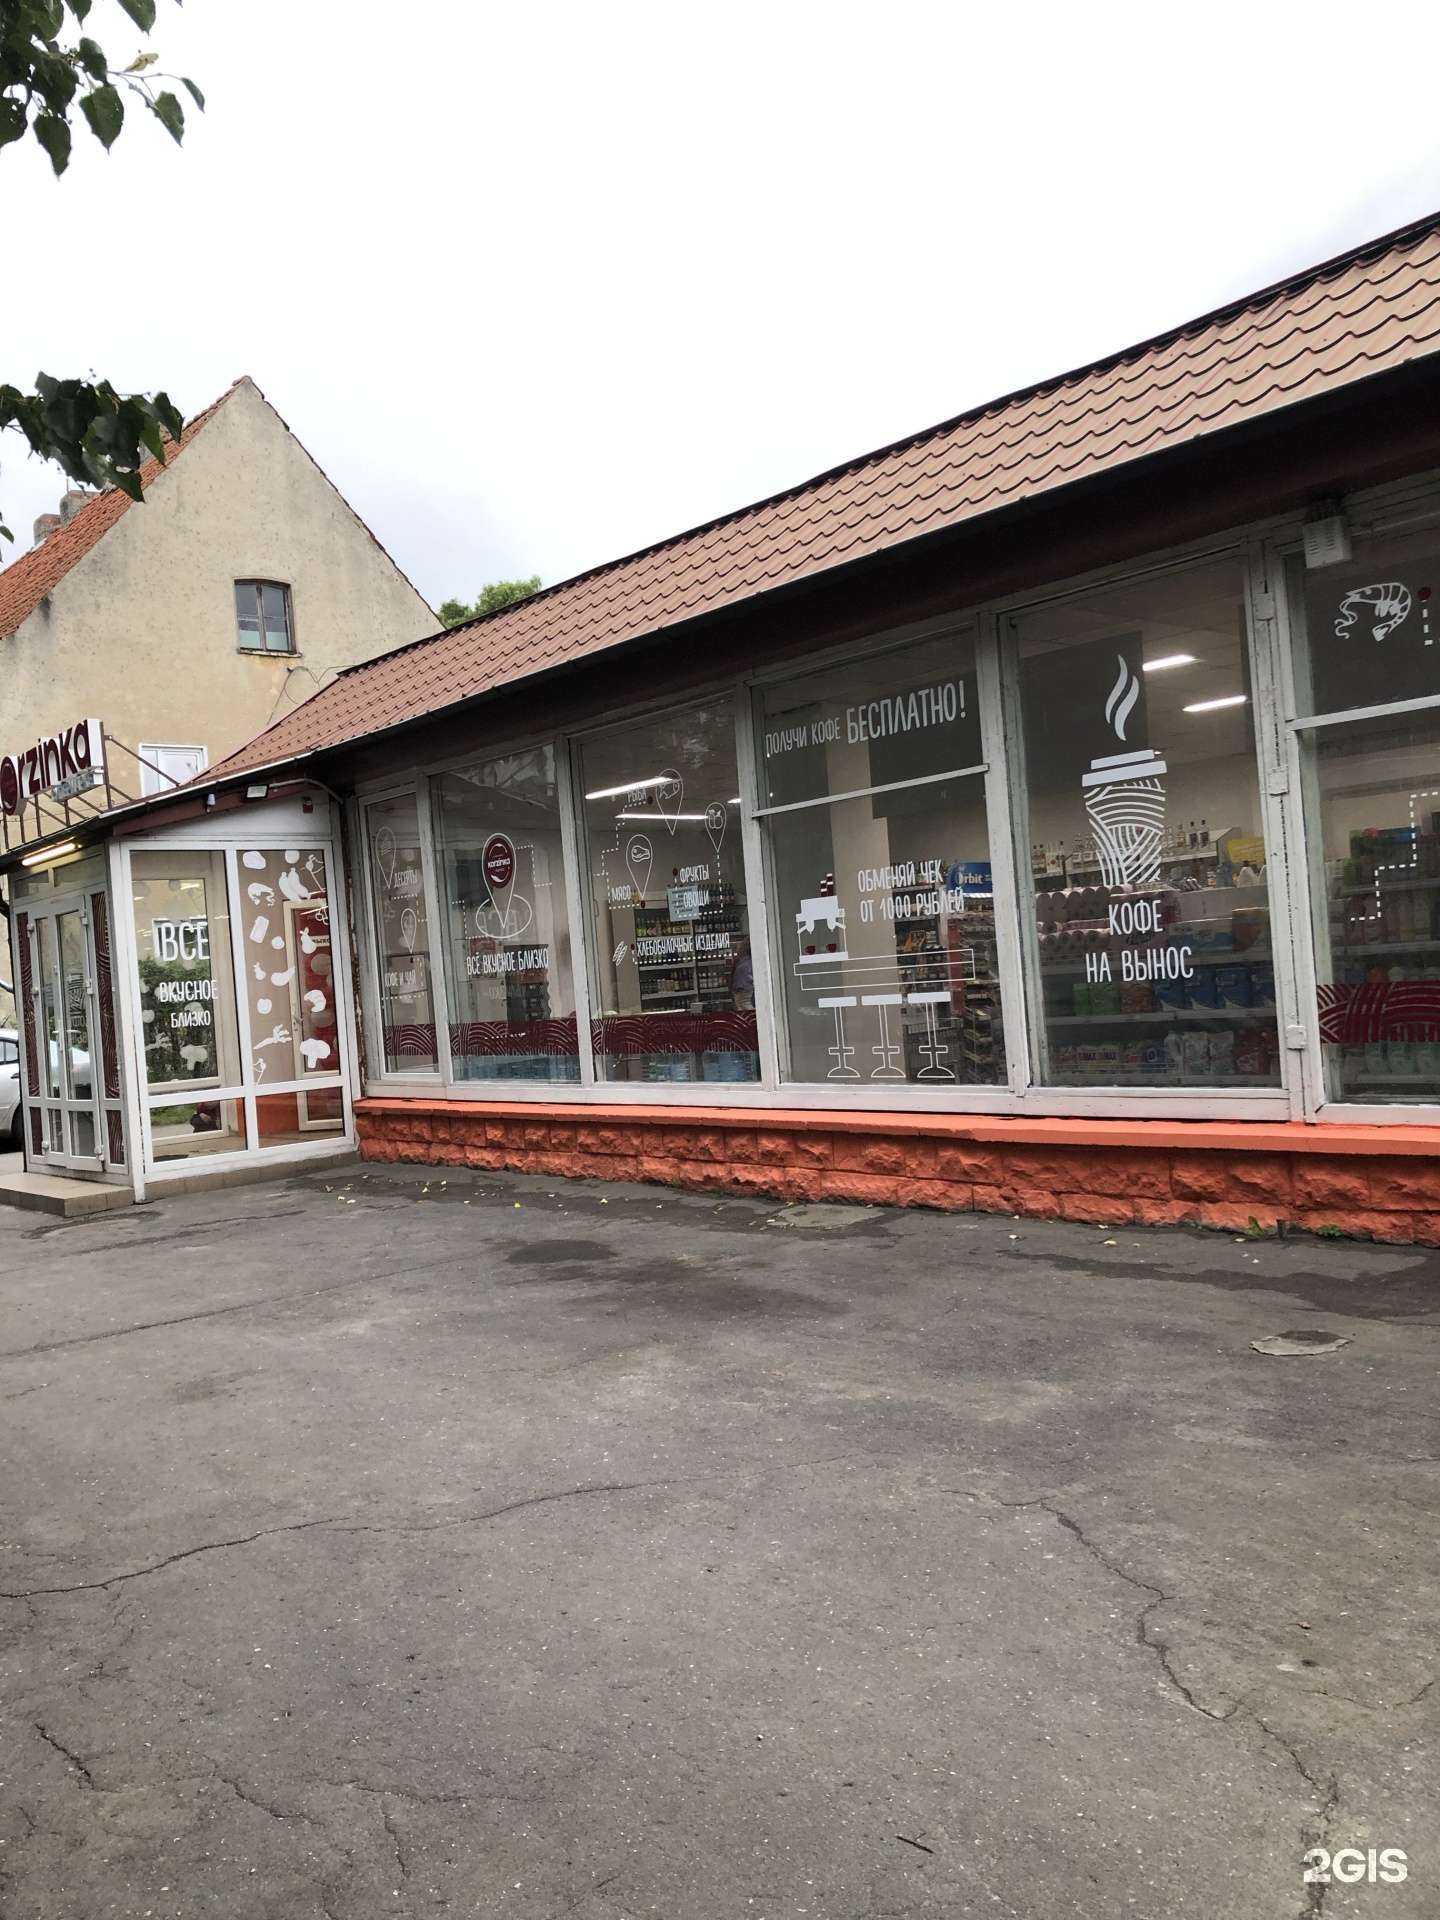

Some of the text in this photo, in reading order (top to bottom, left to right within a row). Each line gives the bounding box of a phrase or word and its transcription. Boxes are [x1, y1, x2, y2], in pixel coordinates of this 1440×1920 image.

[765, 680, 967, 756] ПОЛУЧИ КОФЕ БЕСПЛАТНО!
[0, 719, 92, 816] orzinka
[679, 863, 710, 884] ФРУКТЫ
[858, 859, 944, 893] ОБМЕНЯЙ ЧЕК
[611, 885, 631, 902] МЯСО
[683, 889, 710, 909] ОВОЩИ
[860, 887, 965, 922] ОТ 1000 РУБЛЕЙ
[1108, 899, 1164, 935] КОФЕ
[695, 932, 731, 952] ИЗДЕЛИЯ
[482, 952, 516, 974] ВКУСНОЕ
[517, 948, 549, 971] БЛИЗКО
[1085, 946, 1194, 983] НА ВЫНОС
[159, 979, 219, 1003] ВКУСНОЕ
[170, 1010, 211, 1029] БЛИЗКО
